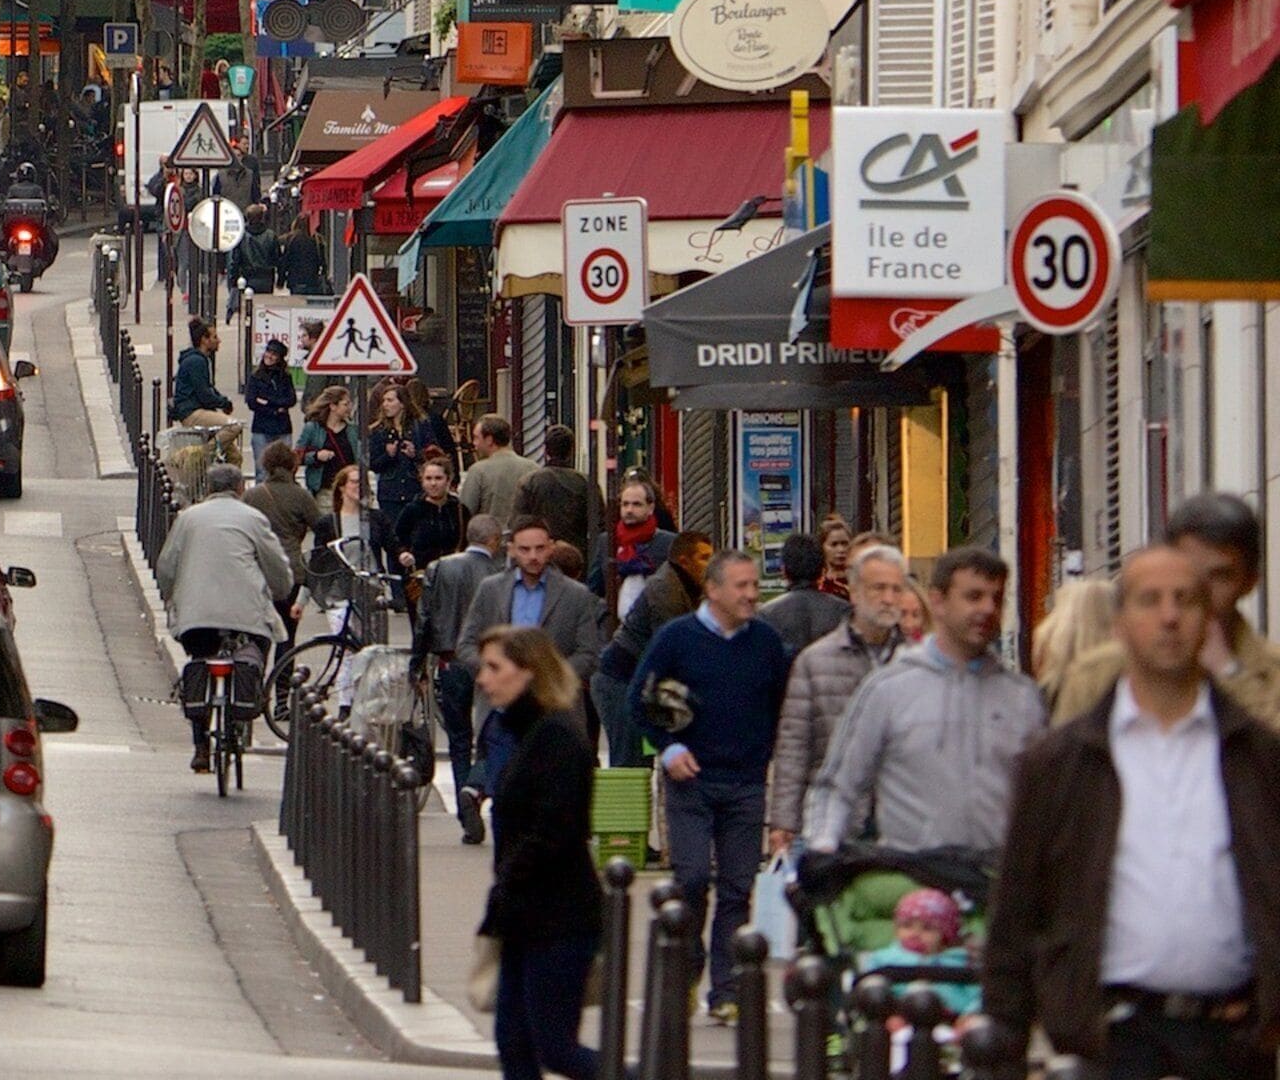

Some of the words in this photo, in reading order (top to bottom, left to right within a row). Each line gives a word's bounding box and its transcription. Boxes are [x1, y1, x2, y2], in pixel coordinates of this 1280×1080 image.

[711, 4, 787, 25] Boulanger
[113, 29, 128, 50] P
[323, 119, 372, 135] Famille
[580, 216, 628, 233] ZONE
[915, 226, 948, 248] de
[867, 256, 962, 280] France
[1032, 234, 1090, 290] 30
[591, 265, 620, 288] 30
[697, 343, 772, 367] DRIDI
